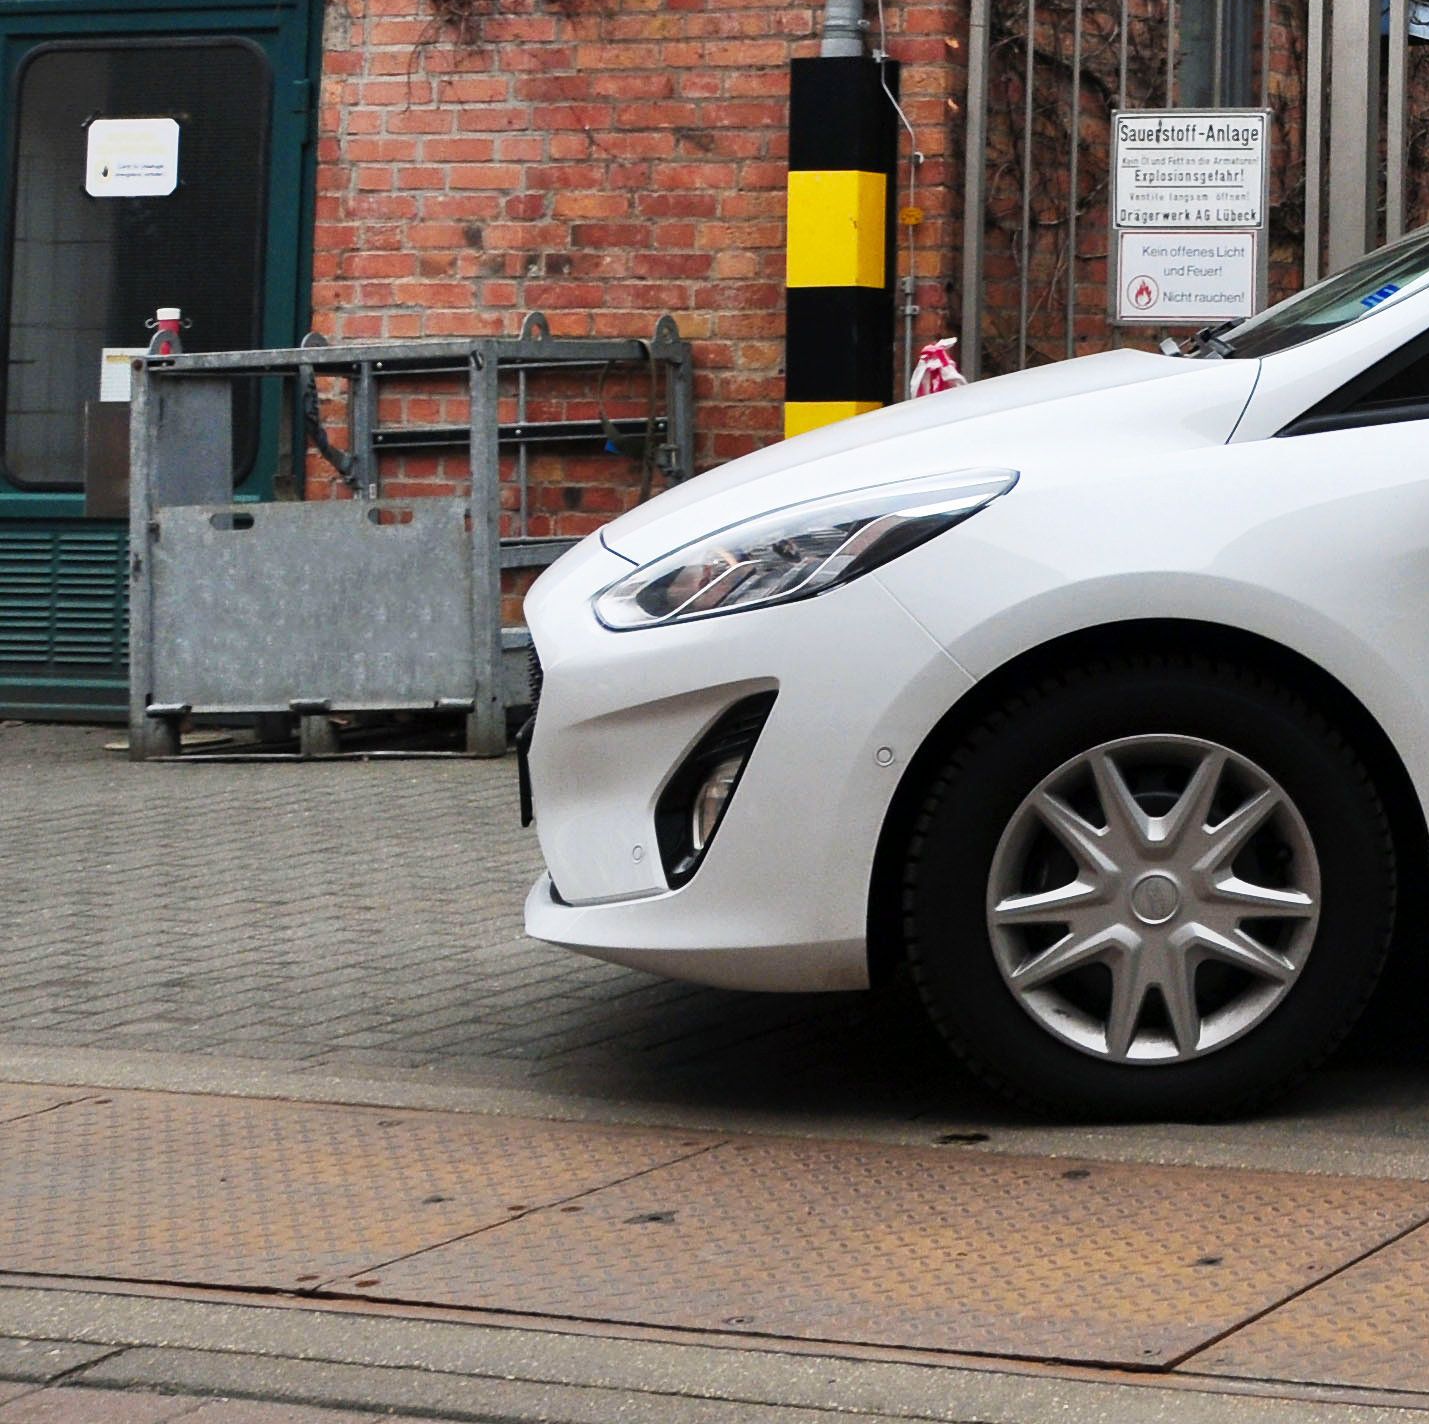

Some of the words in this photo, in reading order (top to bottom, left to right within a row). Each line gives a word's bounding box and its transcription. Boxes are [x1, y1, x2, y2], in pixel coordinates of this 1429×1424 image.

[1120, 123, 1260, 146] Sauerstoff-Anlage
[1134, 169, 1245, 184] Explosionsgefahr!
[1119, 208, 1191, 224] Drägerwerk
[1195, 208, 1210, 222] AG
[1215, 208, 1257, 222] Lübeck
[1142, 245, 1168, 257] Kein
[1169, 245, 1215, 257] offenes
[1216, 245, 1245, 257] Licht
[1163, 265, 1185, 277] und
[1187, 265, 1223, 277] Feuer!
[1162, 291, 1192, 303] Nicht
[1195, 291, 1245, 303] rauchen!
